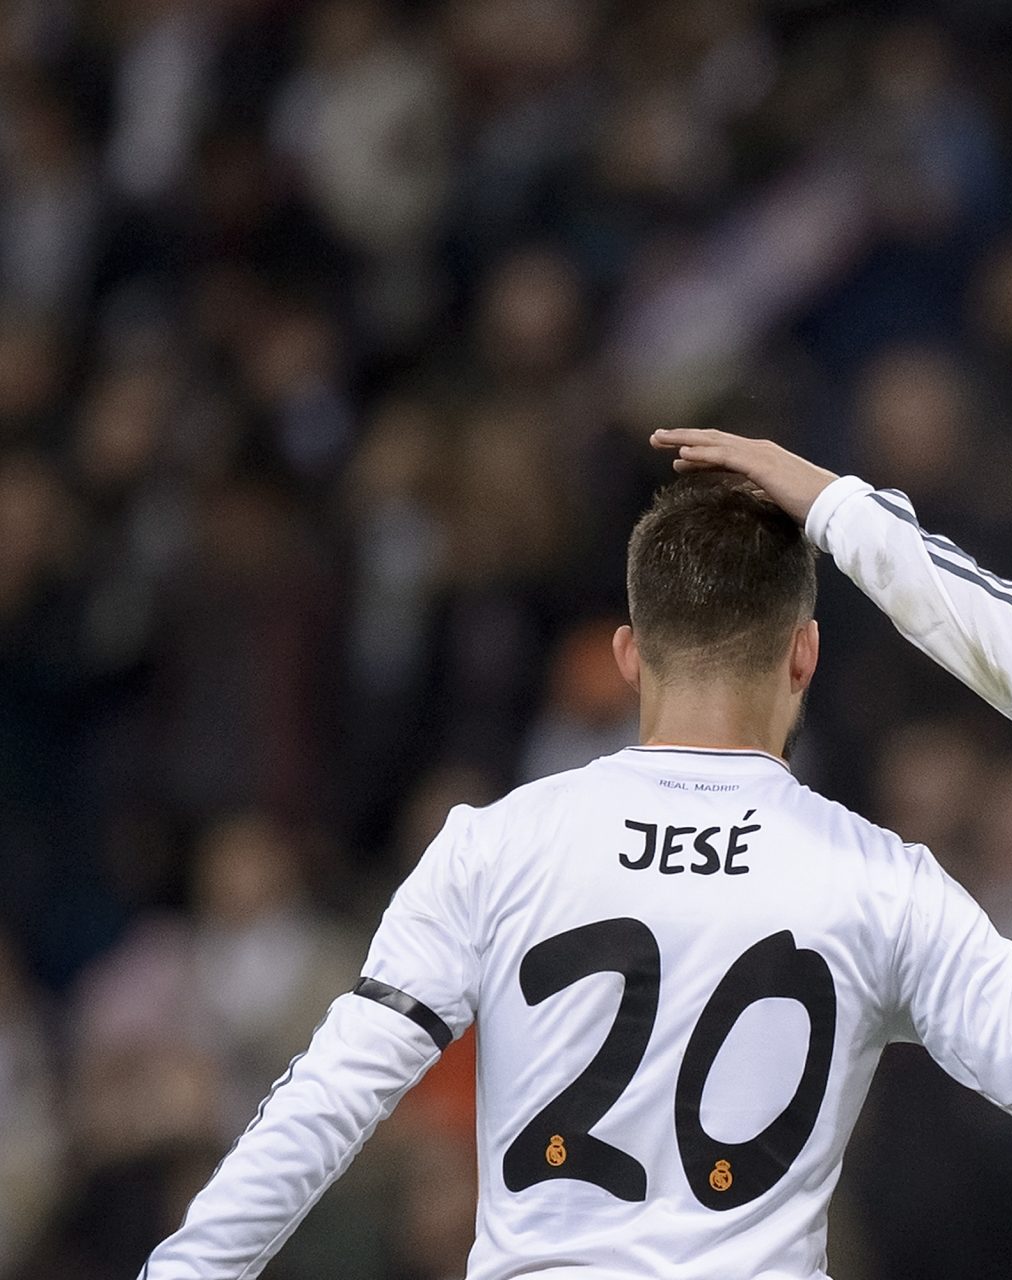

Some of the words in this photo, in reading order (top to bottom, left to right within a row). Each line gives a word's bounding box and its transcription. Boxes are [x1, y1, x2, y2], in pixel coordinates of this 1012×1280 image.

[658, 779, 689, 791] REAL
[618, 808, 762, 876] JESÉ
[502, 916, 837, 1212] 20
